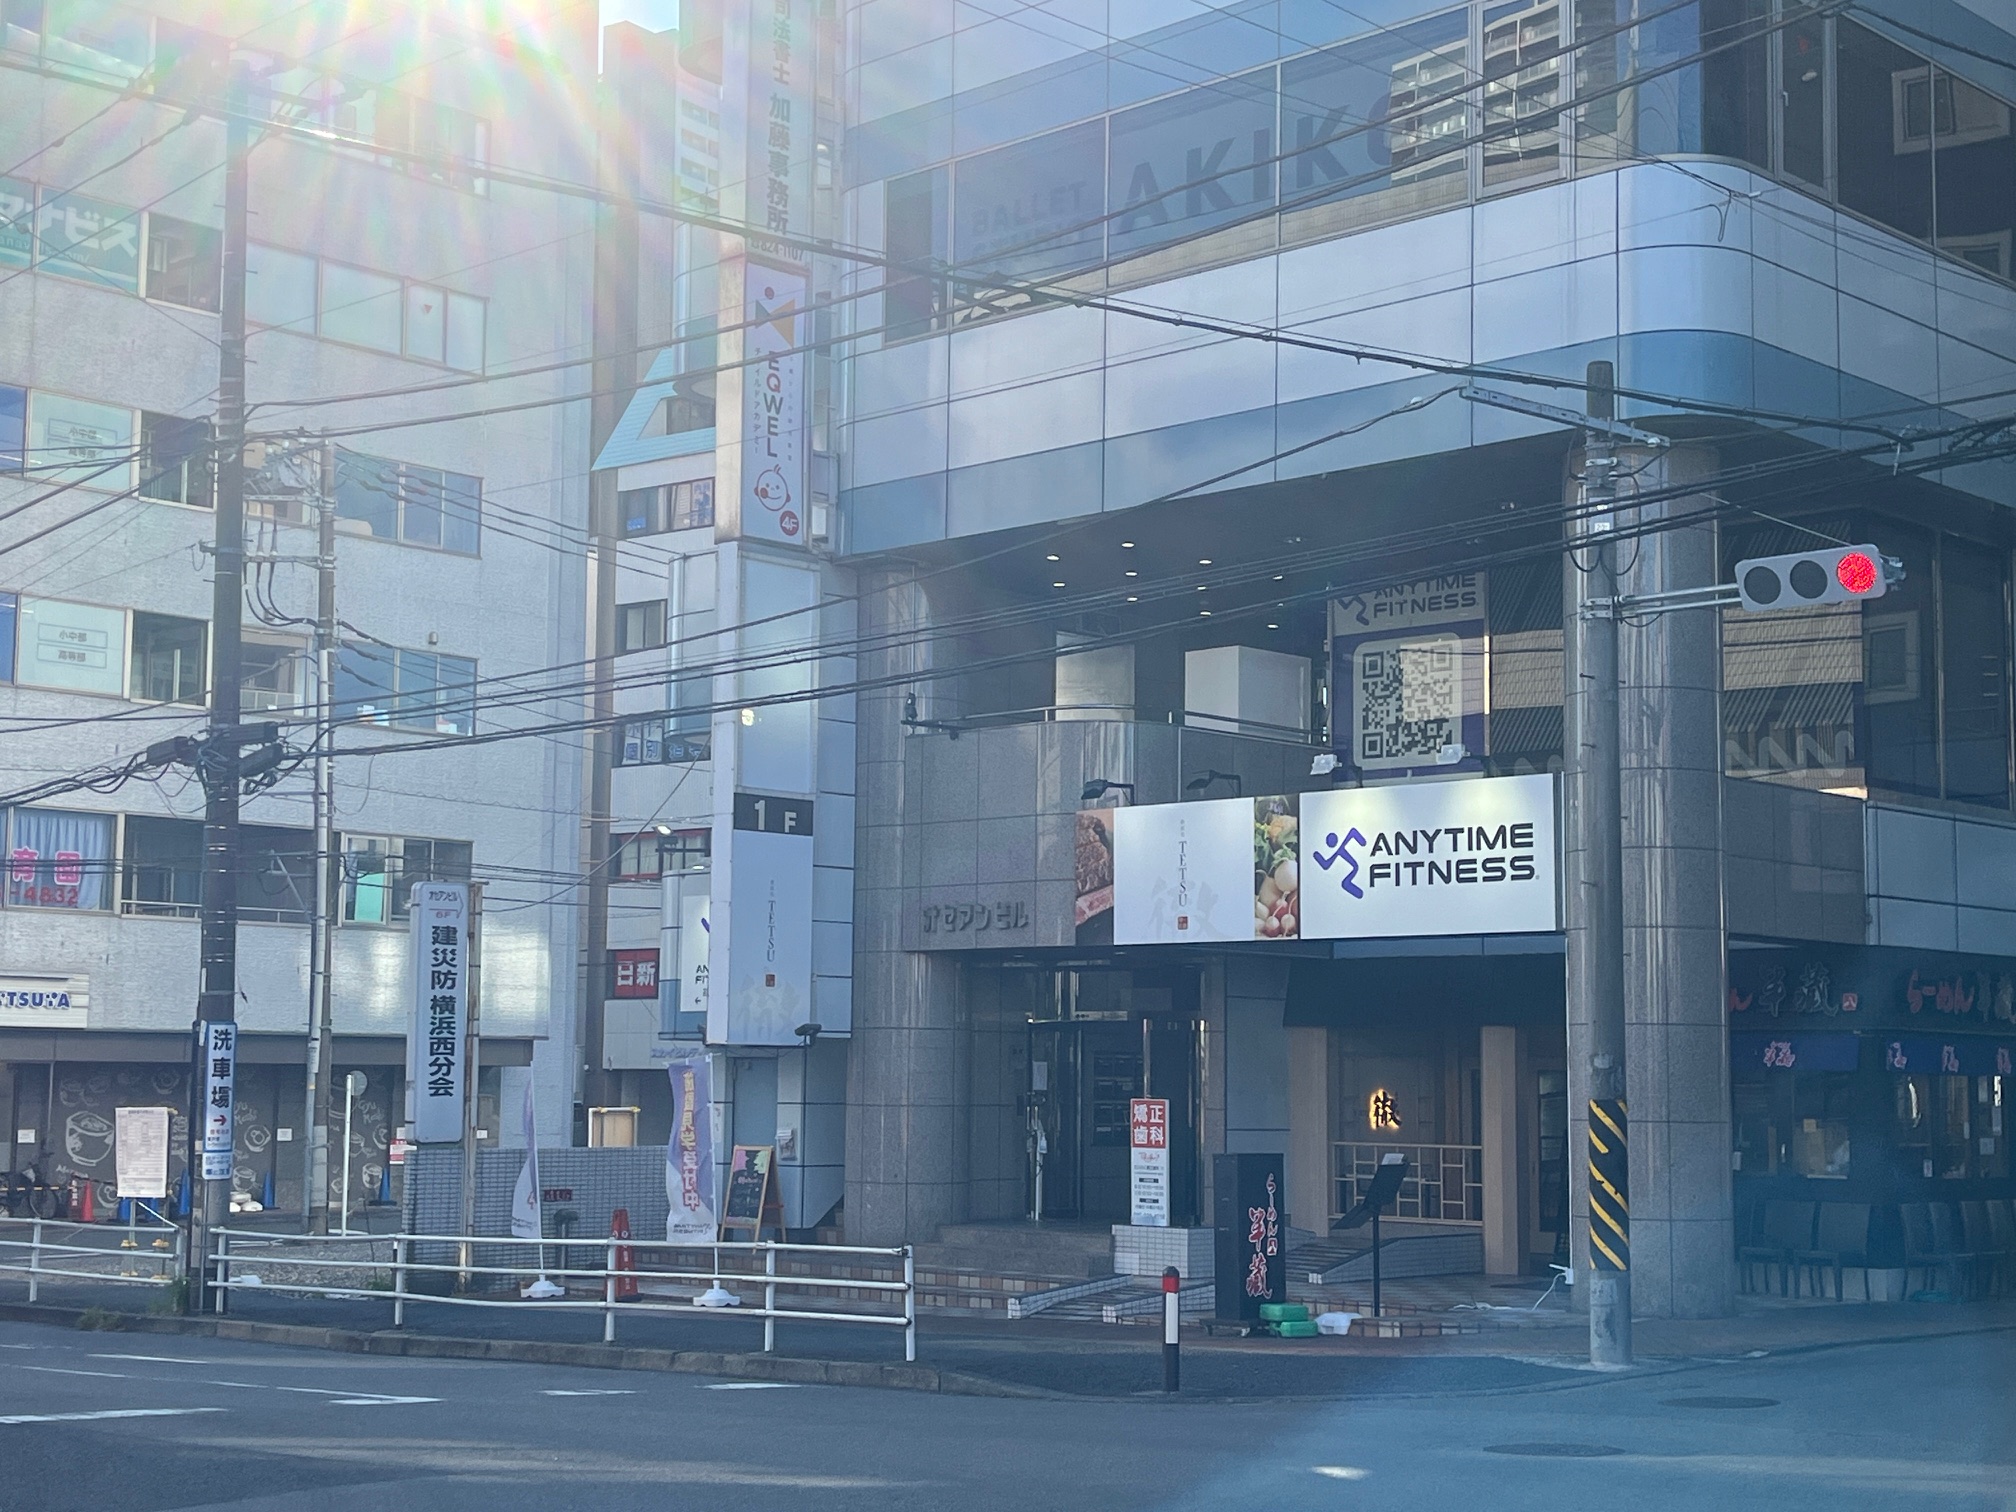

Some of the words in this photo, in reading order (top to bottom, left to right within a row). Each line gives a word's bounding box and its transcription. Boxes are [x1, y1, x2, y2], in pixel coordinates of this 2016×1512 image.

[767, 93, 791, 236] 加藤事務所
[752, 346, 763, 454] チイルドアカデミー
[763, 350, 784, 458] EQWEL
[1373, 590, 1476, 620] FITNESS
[1369, 822, 1534, 857] ANYTIME
[1178, 840, 1188, 908] TETSU
[1369, 855, 1535, 888] FITNESS
[766, 900, 776, 963] TETSU
[923, 900, 1030, 933] オセアンビル
[617, 960, 656, 987] 日新
[211, 1028, 233, 1109] 洗車場
[1133, 1125, 1165, 1145] 歯科
